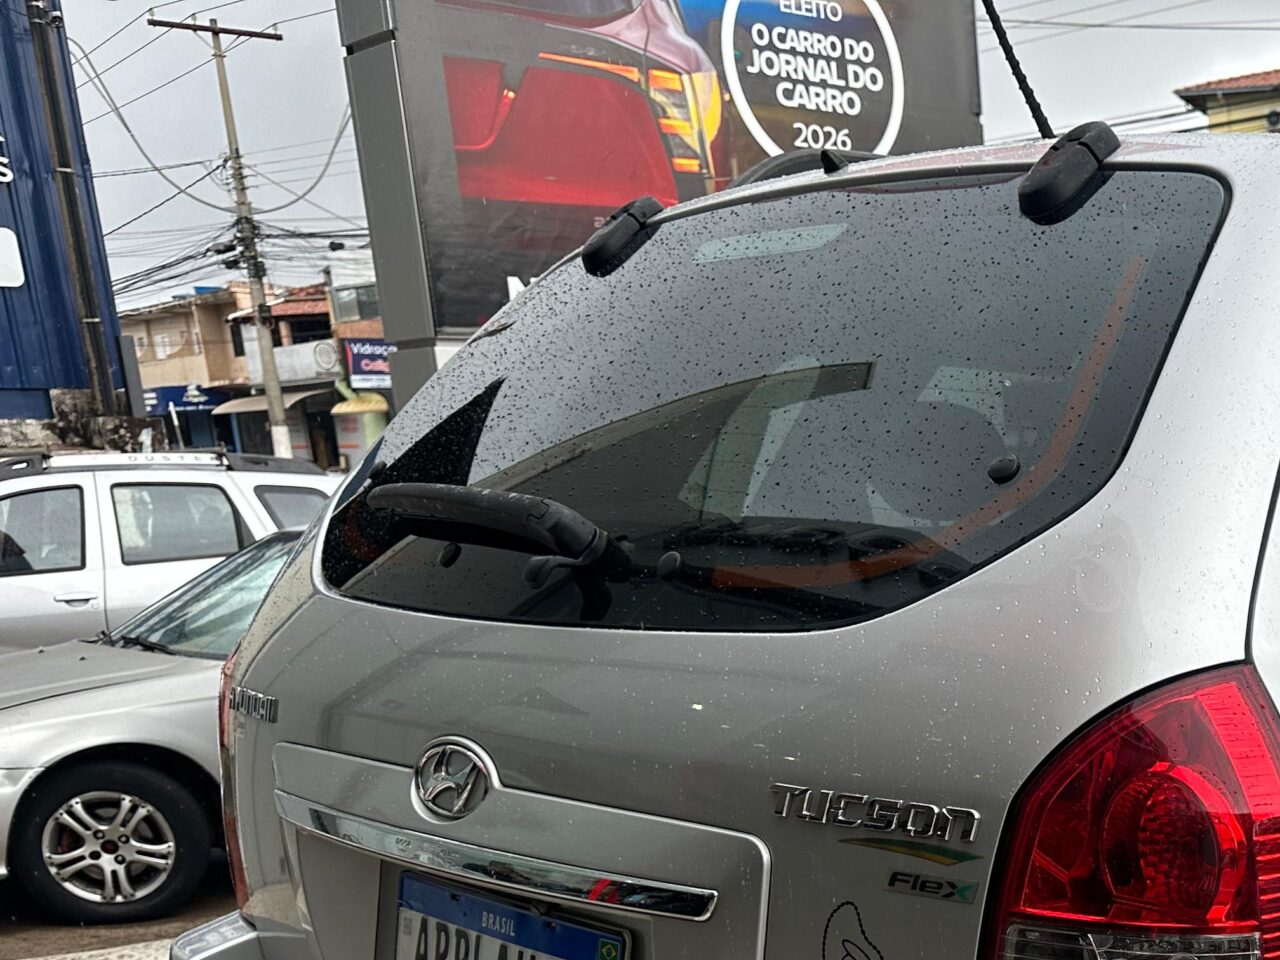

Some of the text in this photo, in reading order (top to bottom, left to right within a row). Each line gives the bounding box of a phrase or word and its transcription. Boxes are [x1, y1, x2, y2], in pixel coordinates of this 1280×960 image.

[780, 0, 842, 22] ELEITO
[751, 22, 874, 63] O CARRO DO
[747, 48, 884, 92] JORNAL DO
[776, 81, 861, 116] CARRO
[793, 122, 852, 151] 2026
[770, 782, 982, 842] TUCSON
[481, 911, 516, 937] BRASIL
